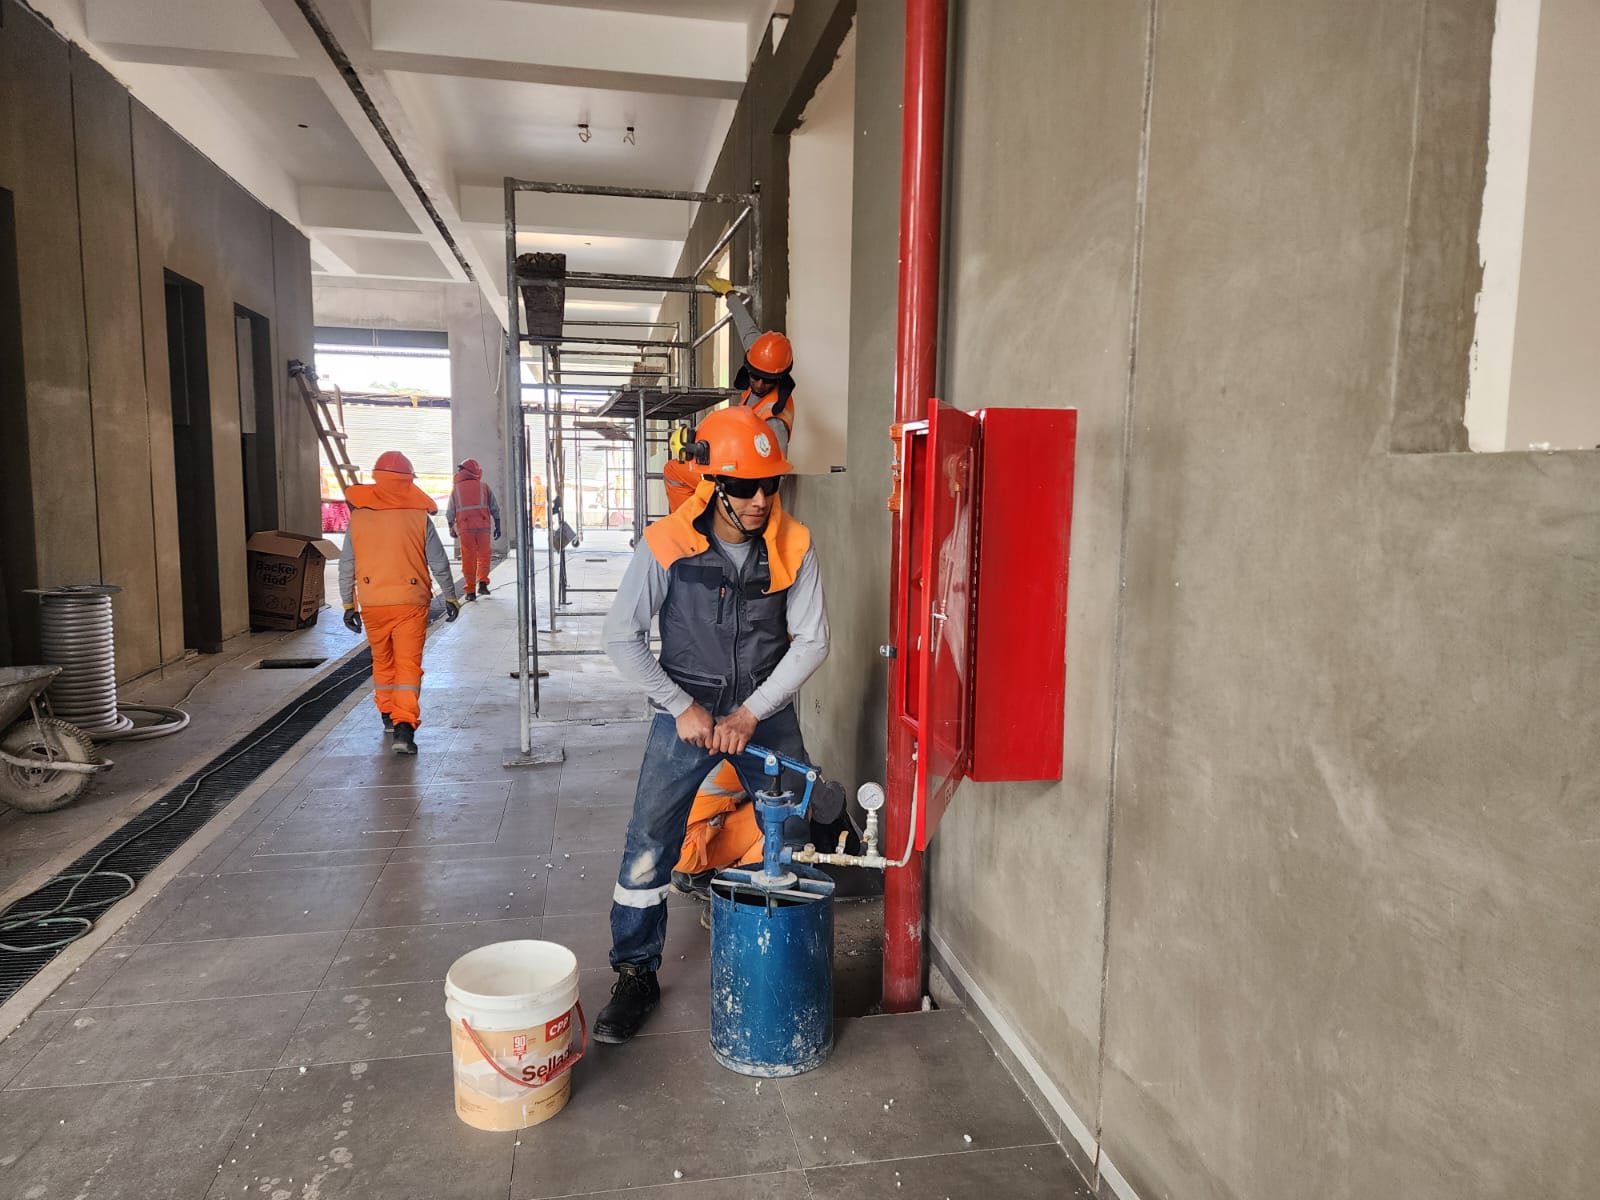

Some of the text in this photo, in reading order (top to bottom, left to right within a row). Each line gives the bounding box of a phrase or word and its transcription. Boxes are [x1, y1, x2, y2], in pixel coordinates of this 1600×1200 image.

[256, 560, 297, 575] Backer
[263, 573, 287, 586] Rod
[549, 1016, 569, 1036] CPP
[514, 1035, 526, 1048] 90
